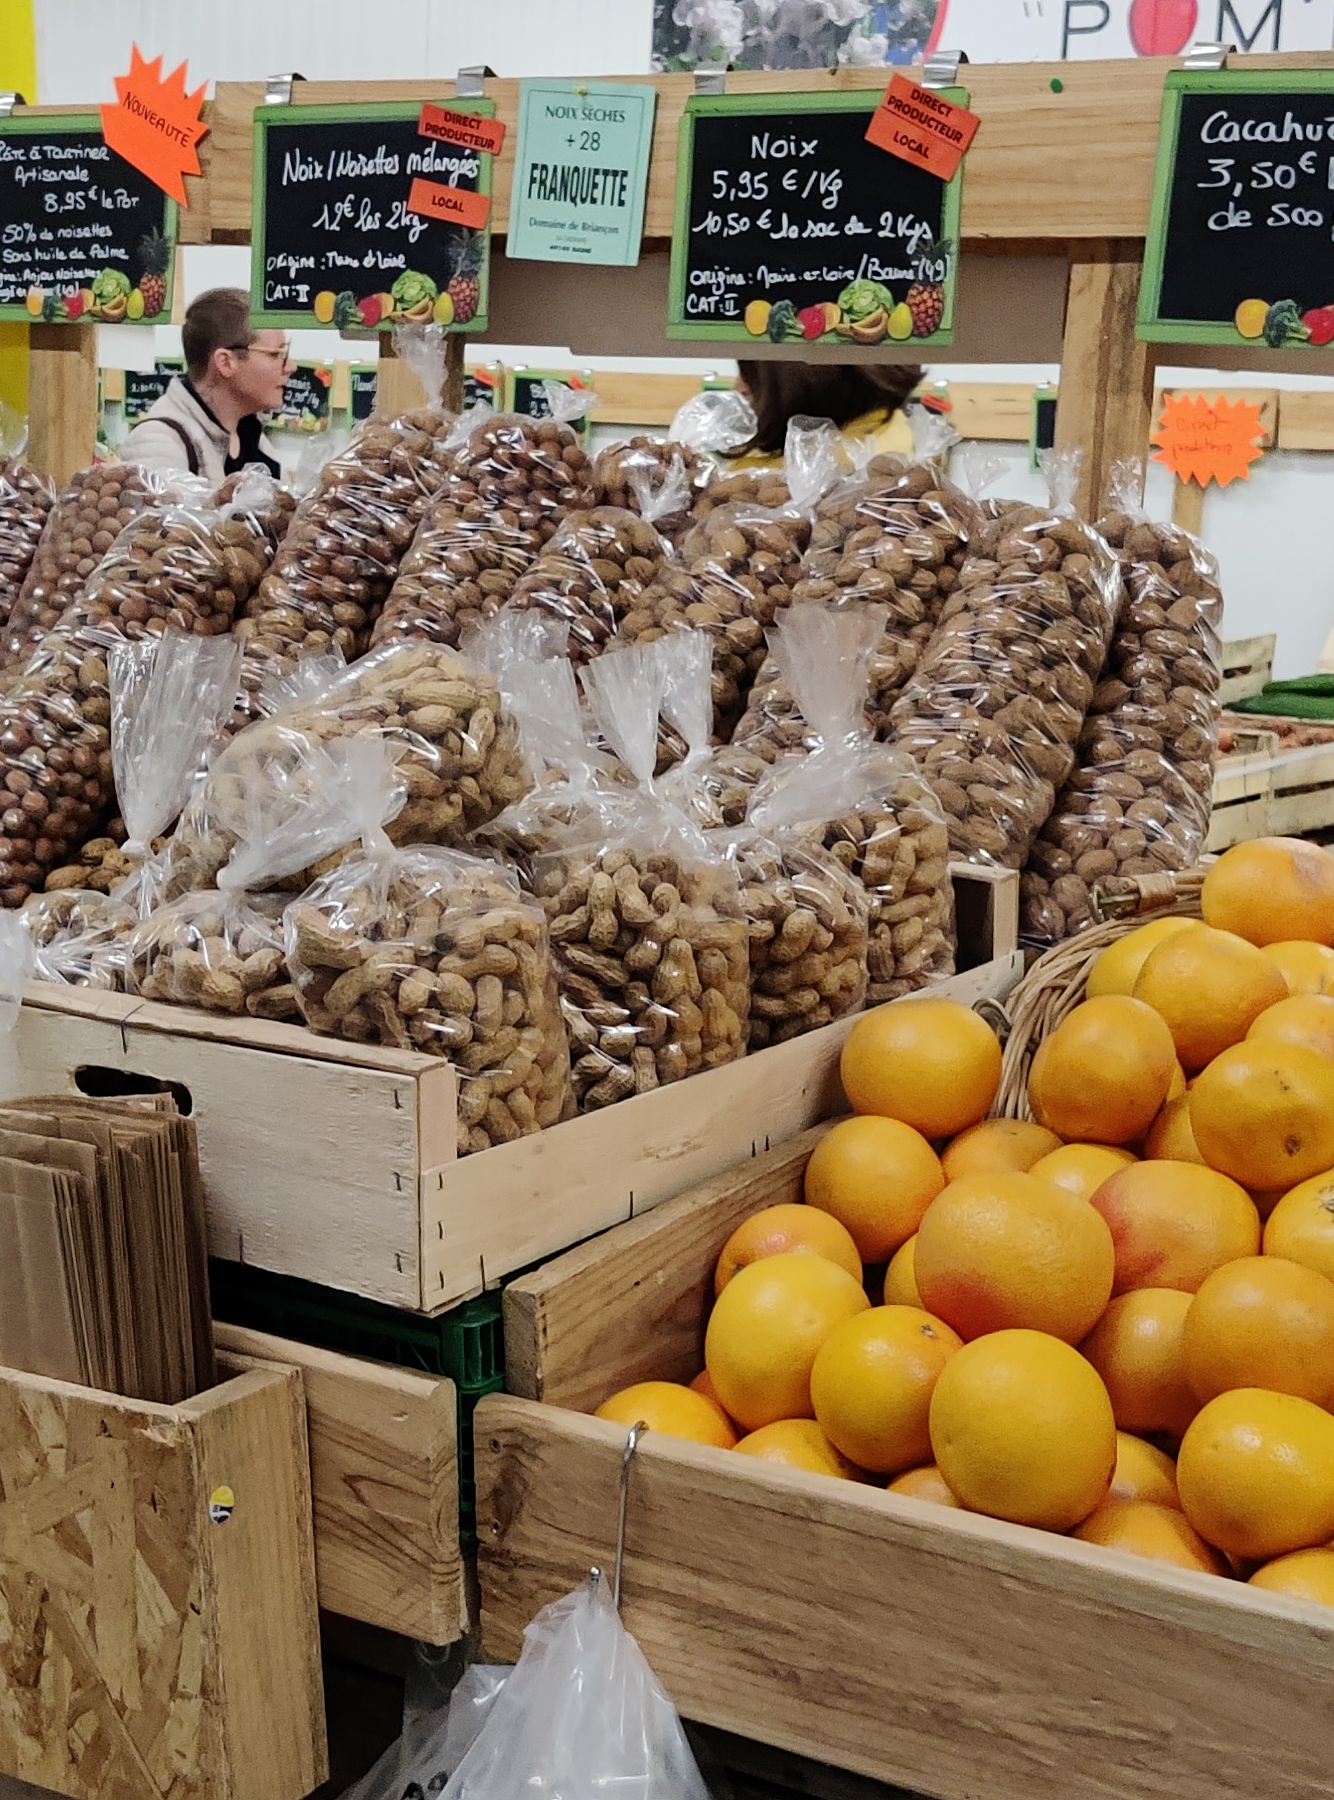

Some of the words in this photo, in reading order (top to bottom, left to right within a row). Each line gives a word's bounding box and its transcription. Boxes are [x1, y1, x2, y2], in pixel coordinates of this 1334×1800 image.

[545, 105, 578, 120] NOIX
[910, 87, 953, 118] DIRECT
[443, 111, 482, 130] DIRECT
[886, 95, 963, 143] PRODUCTEUR
[424, 122, 495, 150] PRODUCTEUR
[580, 130, 601, 151] 28
[750, 132, 818, 159] Noix
[893, 130, 930, 159] LOCAL
[15, 165, 89, 187] Artisanale
[528, 162, 629, 207] FRANQUETTE
[431, 195, 464, 213] LOCAL
[529, 217, 566, 230] Domaine
[569, 221, 578, 231] de
[801, 214, 840, 237] sac
[1207, 201, 1253, 231] de
[58, 223, 113, 237] noisettes
[35, 247, 67, 260] huile
